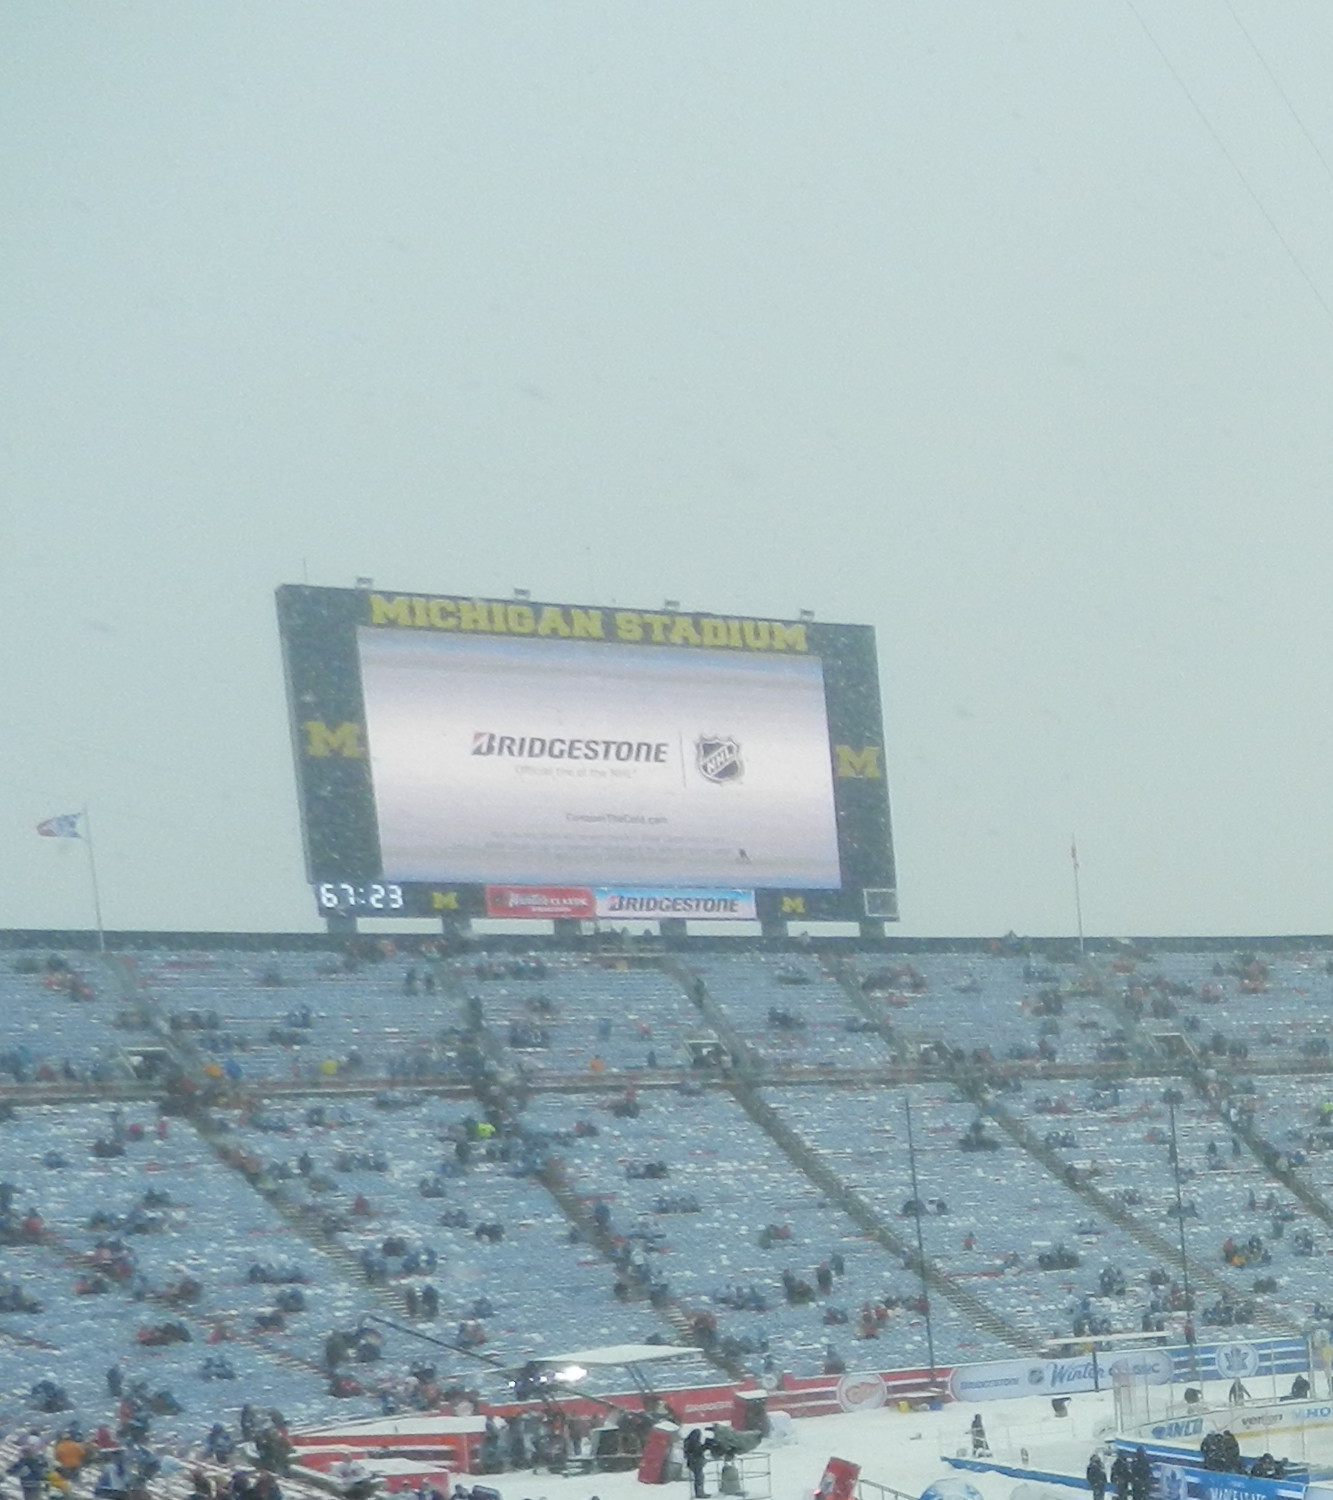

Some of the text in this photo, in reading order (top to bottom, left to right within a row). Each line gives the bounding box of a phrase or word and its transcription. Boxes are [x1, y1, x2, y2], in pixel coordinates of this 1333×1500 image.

[370, 594, 808, 652] MICHIGAN STADIUM
[471, 732, 669, 763] BRIDGESTONE
[706, 741, 735, 777] NHL
[320, 884, 403, 910] 67:23
[608, 895, 738, 913] BRIDGESTONE
[1046, 1363, 1107, 1387] Winter
